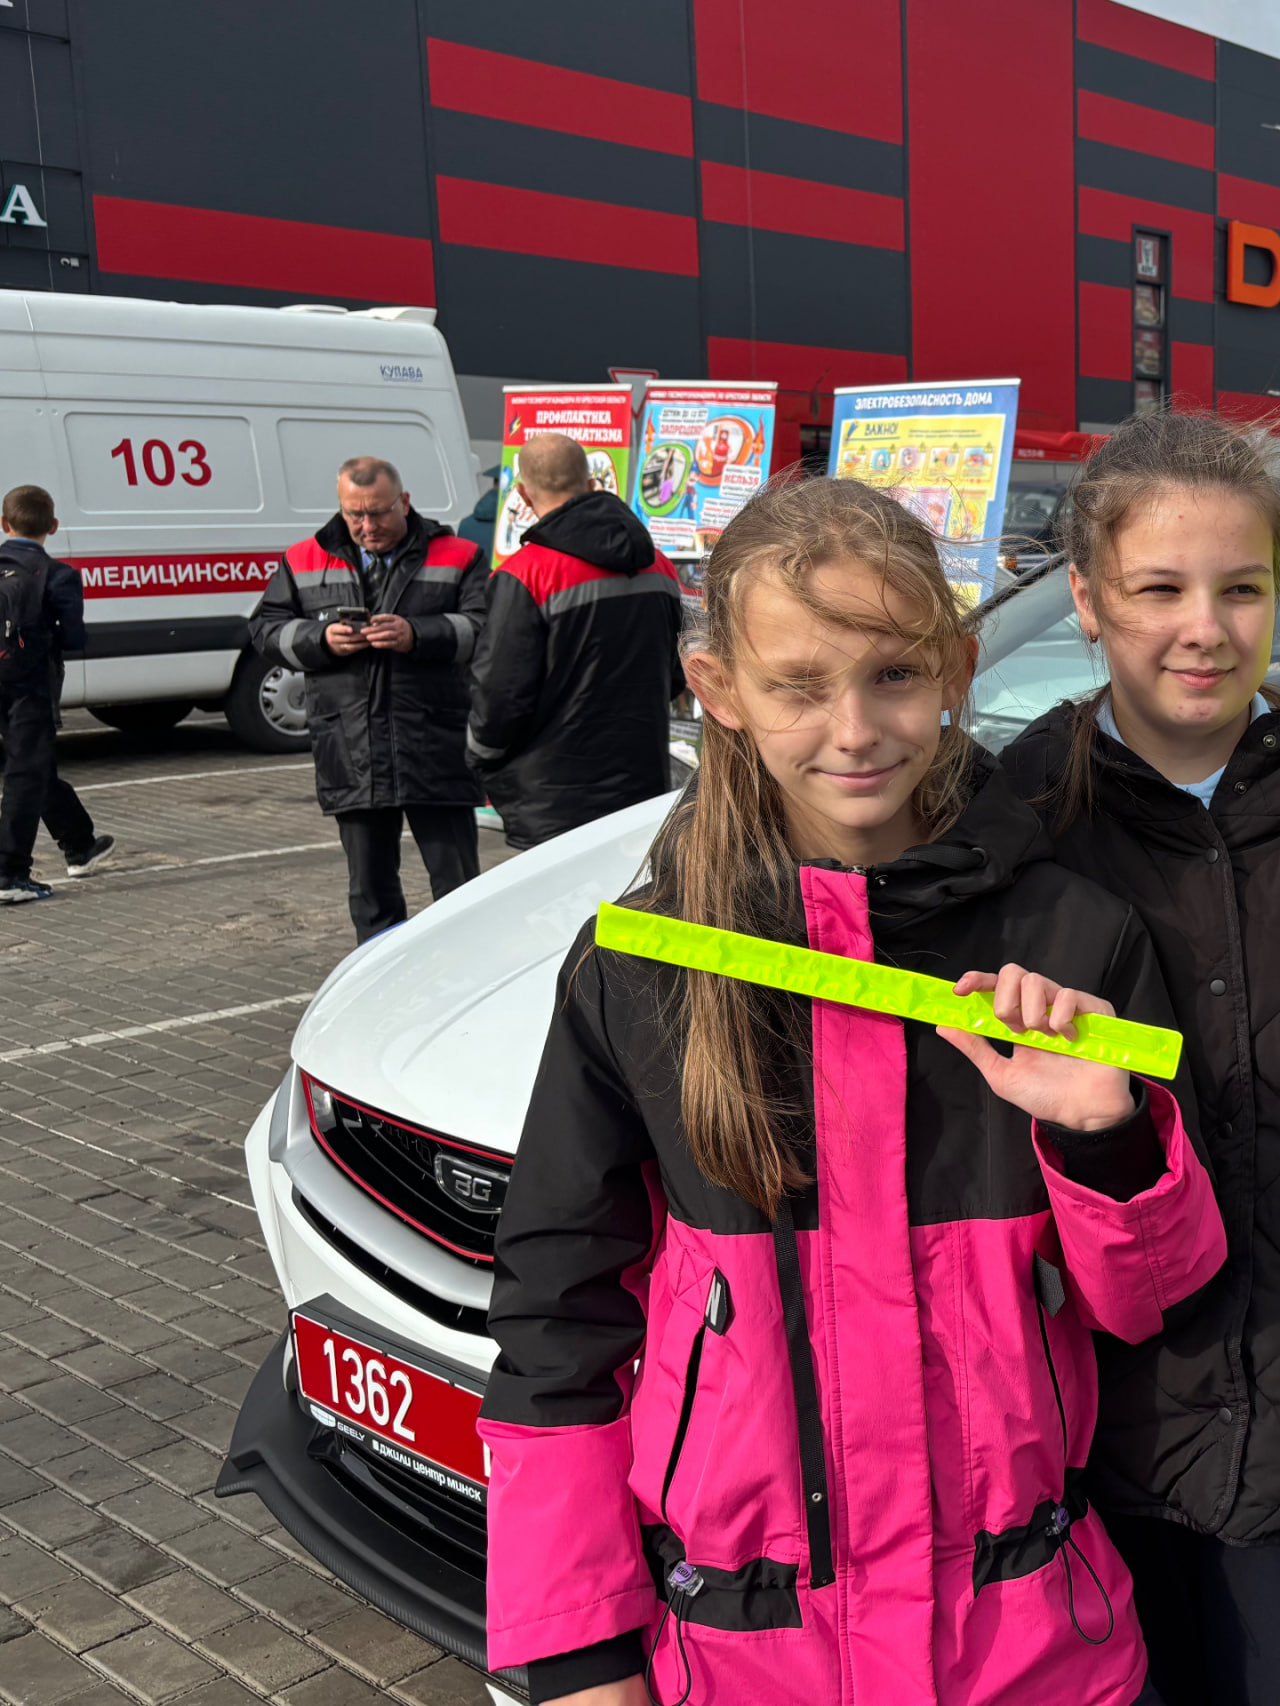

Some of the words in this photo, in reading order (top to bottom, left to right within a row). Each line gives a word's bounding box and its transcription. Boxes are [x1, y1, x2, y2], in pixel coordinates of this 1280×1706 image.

[855, 393, 963, 411] ЭЛЕКТРОБЕЗОПАСНОСТЬ
[964, 391, 993, 408] ДОМА
[536, 410, 612, 425] ПРОФИЛАКТИКА
[111, 438, 212, 487] 103
[81, 561, 279, 589] МЕДИЦИНСКАЯ
[322, 1338, 416, 1442] 1362
[337, 1421, 366, 1442] GEELY
[379, 1443, 412, 1468] джили
[412, 1459, 446, 1487] центр
[447, 1476, 482, 1502] минск
